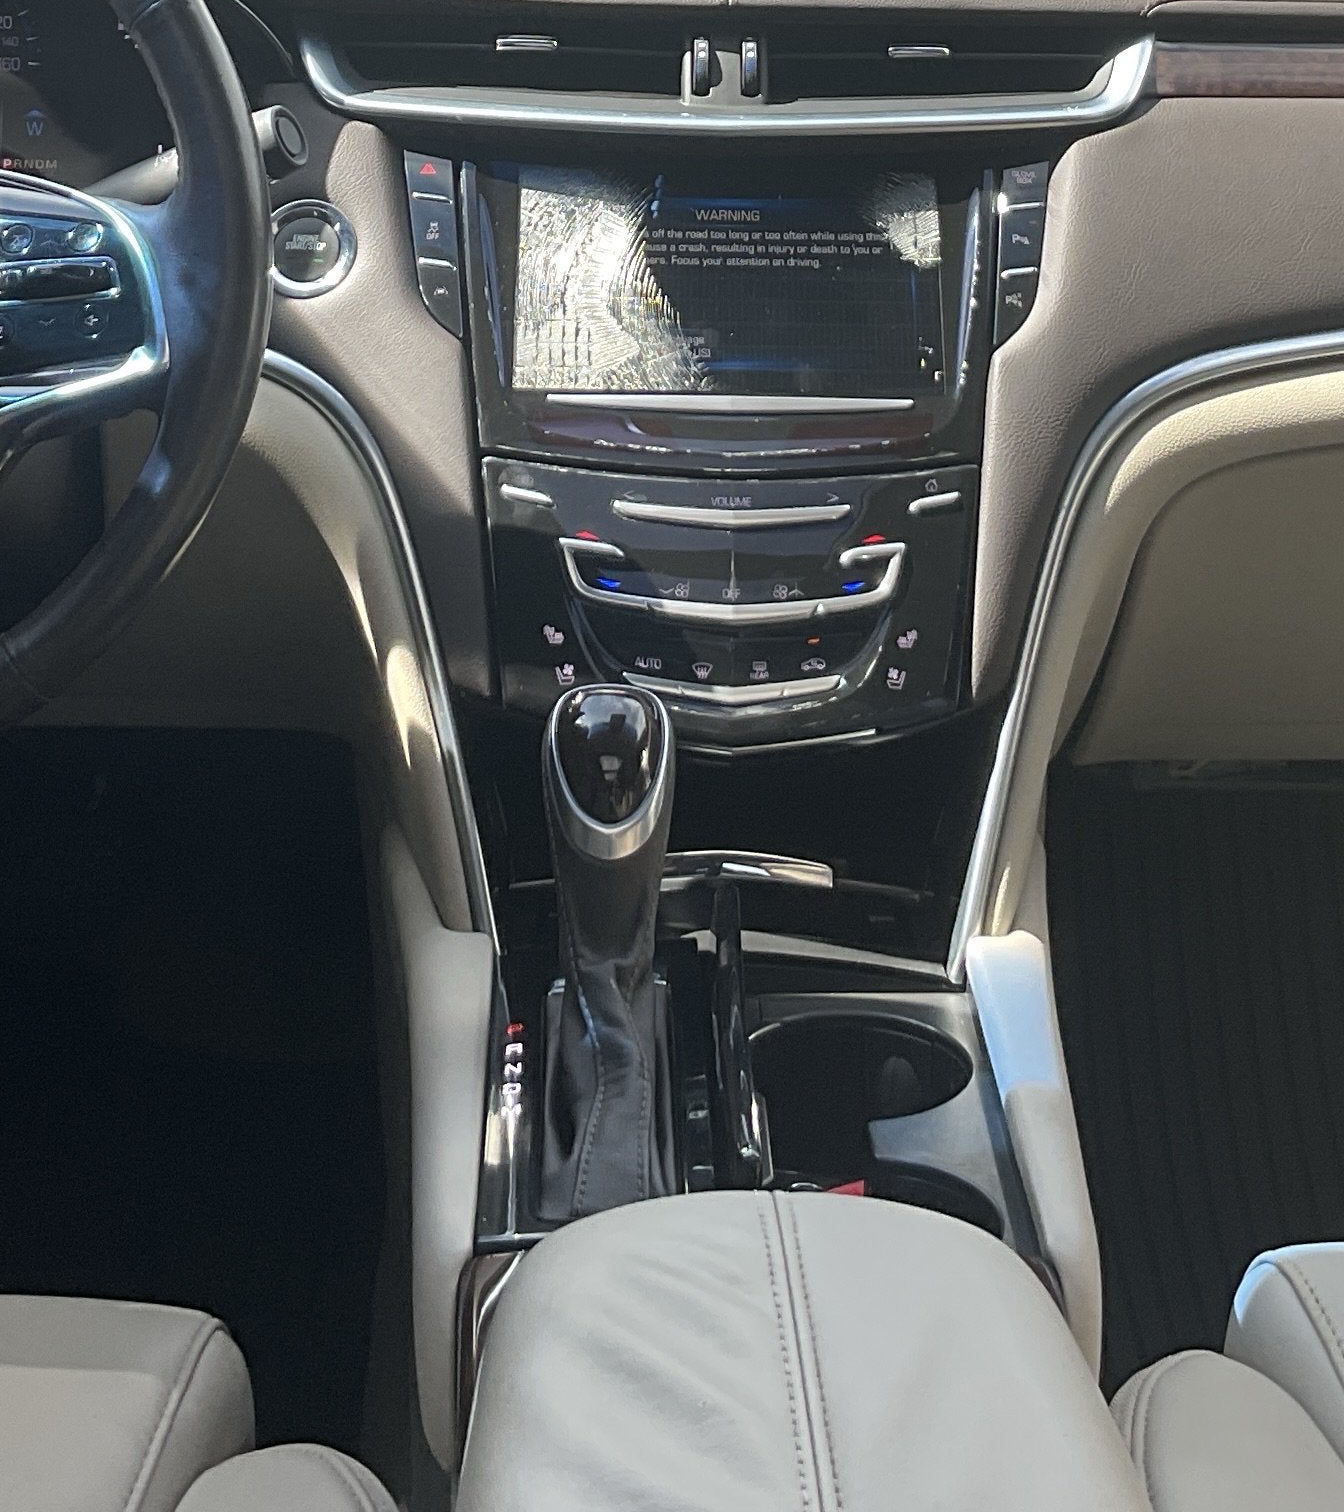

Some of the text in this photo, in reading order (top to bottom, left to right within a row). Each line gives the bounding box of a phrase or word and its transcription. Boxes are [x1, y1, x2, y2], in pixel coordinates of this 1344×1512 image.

[25, 121, 45, 137] W
[695, 209, 761, 222] WARNING
[667, 228, 683, 239] the
[685, 228, 708, 239] road
[710, 230, 726, 239] too
[729, 229, 749, 242] long
[765, 231, 781, 240] too
[783, 230, 808, 241] often
[810, 230, 835, 241] while
[837, 231, 864, 243] using
[711, 243, 755, 255] resulting
[757, 243, 766, 252] in
[768, 244, 795, 255] injury
[810, 244, 837, 254] death
[840, 245, 850, 255] to
[854, 246, 870, 256] you
[671, 255, 700, 265] Focus
[702, 257, 723, 268] your
[726, 256, 770, 266] attention
[772, 257, 785, 266] on
[710, 496, 753, 507] VOLUME
[634, 656, 662, 670] AUTO
